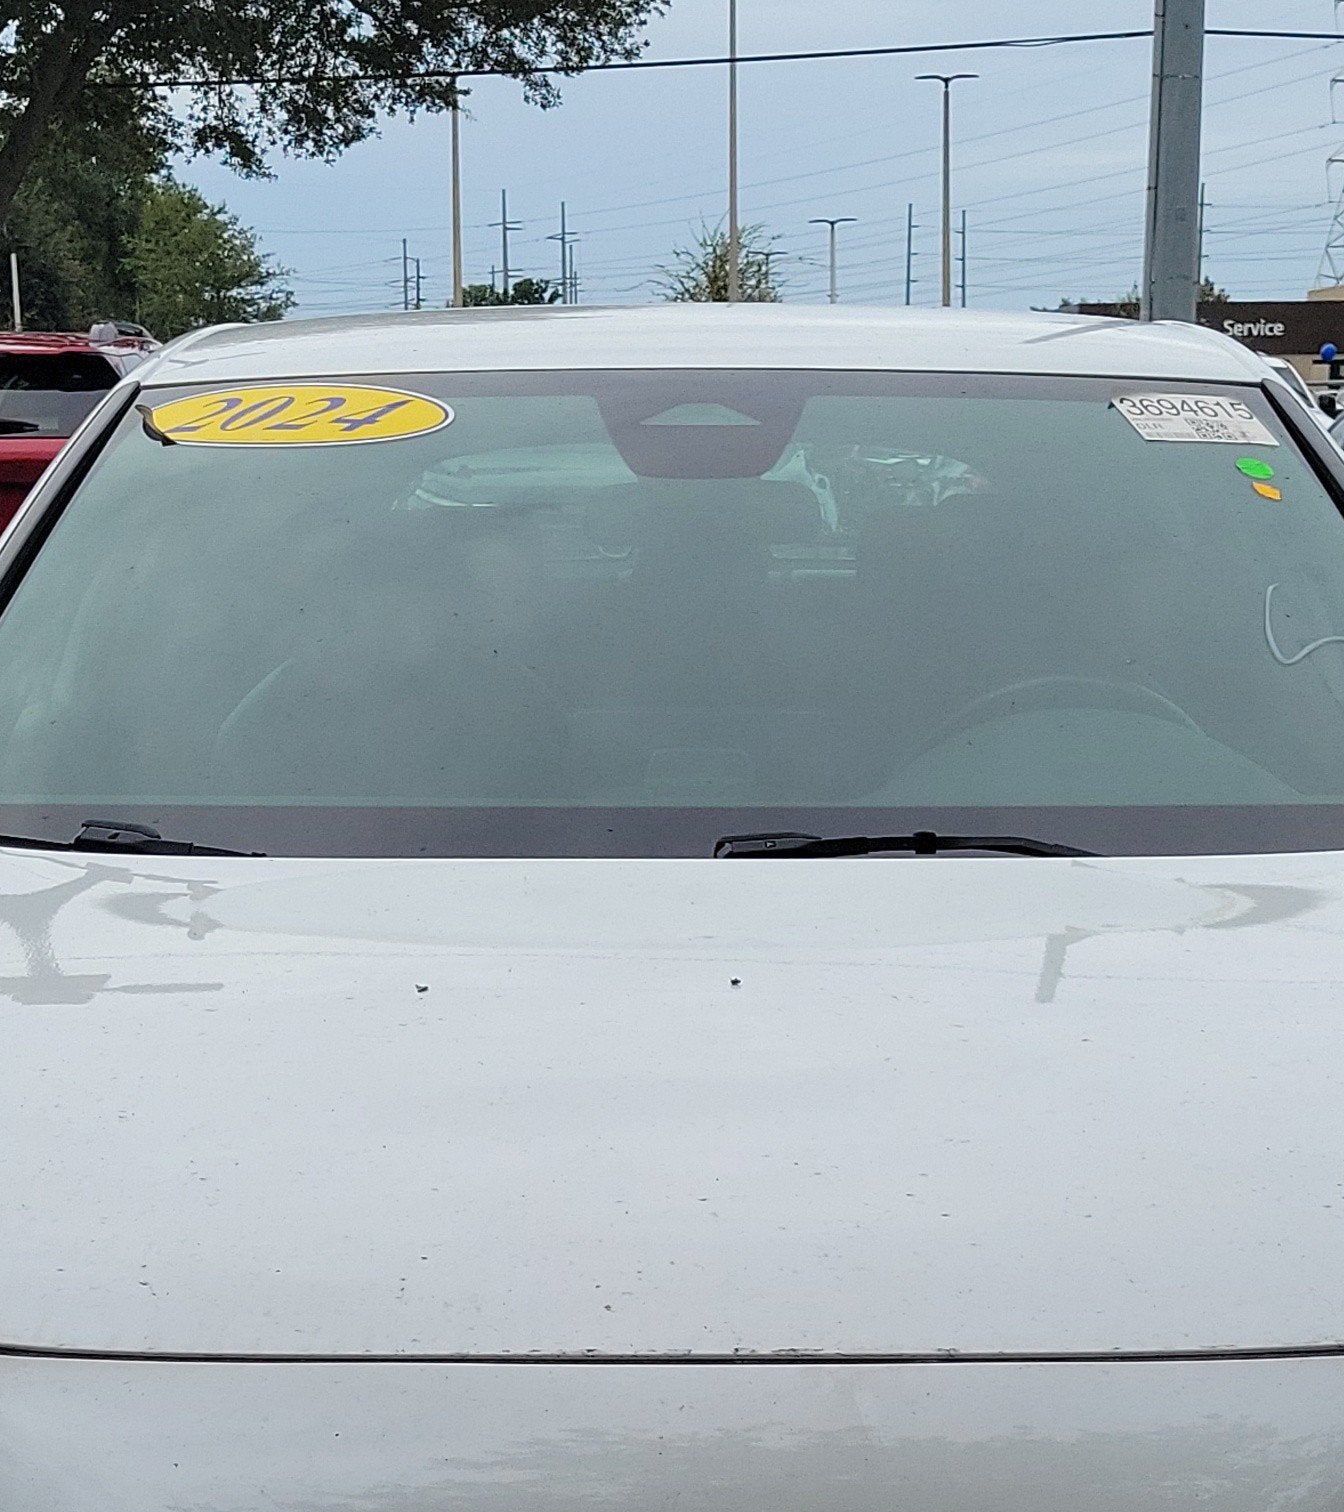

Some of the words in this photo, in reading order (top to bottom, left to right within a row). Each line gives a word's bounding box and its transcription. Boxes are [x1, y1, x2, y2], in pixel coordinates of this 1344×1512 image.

[1223, 318, 1285, 336] Service
[164, 396, 414, 433] 2024
[1119, 397, 1254, 420] 3694615
